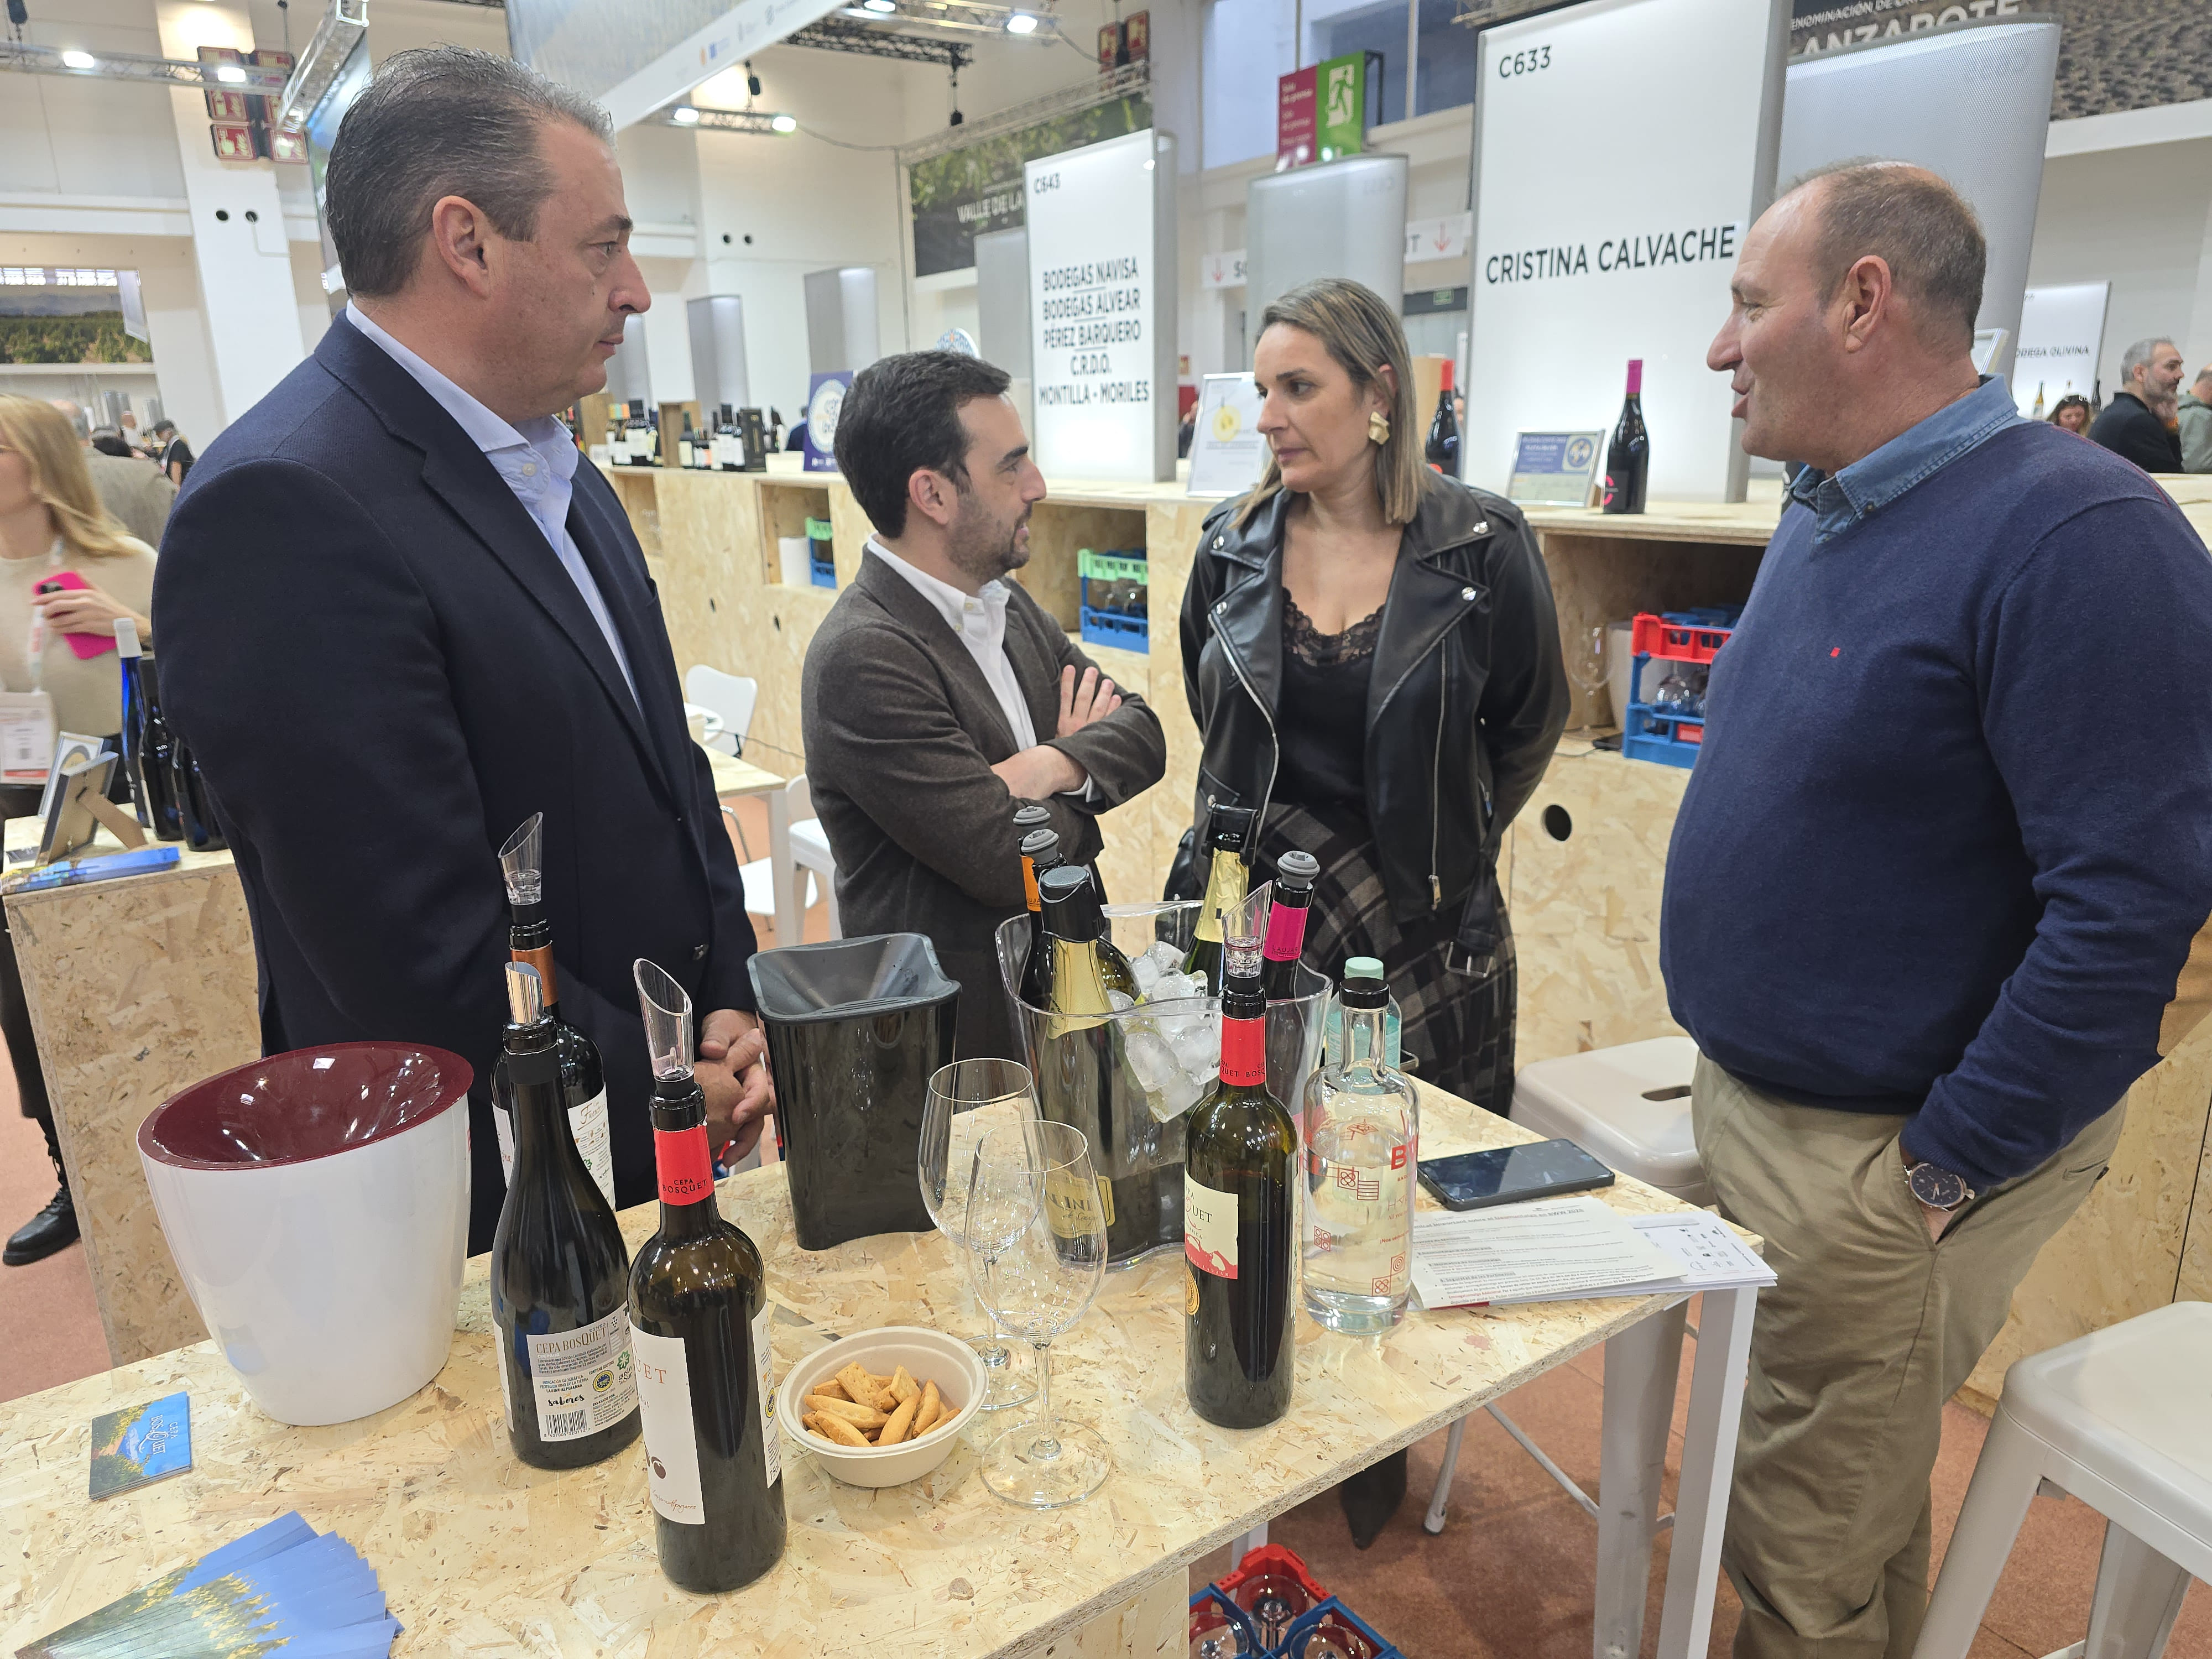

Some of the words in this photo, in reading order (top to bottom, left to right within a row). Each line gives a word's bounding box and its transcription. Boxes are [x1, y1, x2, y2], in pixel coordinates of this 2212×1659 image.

[1791, 2, 1874, 30] ENOMINACIÓN
[1499, 44, 1553, 79] C633
[1485, 243, 1589, 284] CRISTINA
[1598, 224, 1736, 272] CALVACHE
[1043, 264, 1093, 291] BODEGAS
[1095, 256, 1139, 284] NAVISA
[1043, 295, 1093, 320] BODEGAS
[1095, 287, 1141, 314] ALVEAR
[1044, 323, 1076, 349] PÉREZ
[1079, 319, 1141, 346] BARQUERO
[1039, 383, 1091, 406] MONTILLA
[1100, 380, 1149, 404] MORILES
[1246, 1067, 1265, 1078] BOSQ
[662, 1178, 707, 1195] BOSQUET
[536, 1341, 561, 1354] CEPA
[563, 1327, 607, 1351] BOSQUET
[589, 1322, 606, 1333] TINTO
[548, 1394, 585, 1406] sabores
[138, 1414, 169, 1455] BOSQUET
[169, 1422, 178, 1439] CEPA
